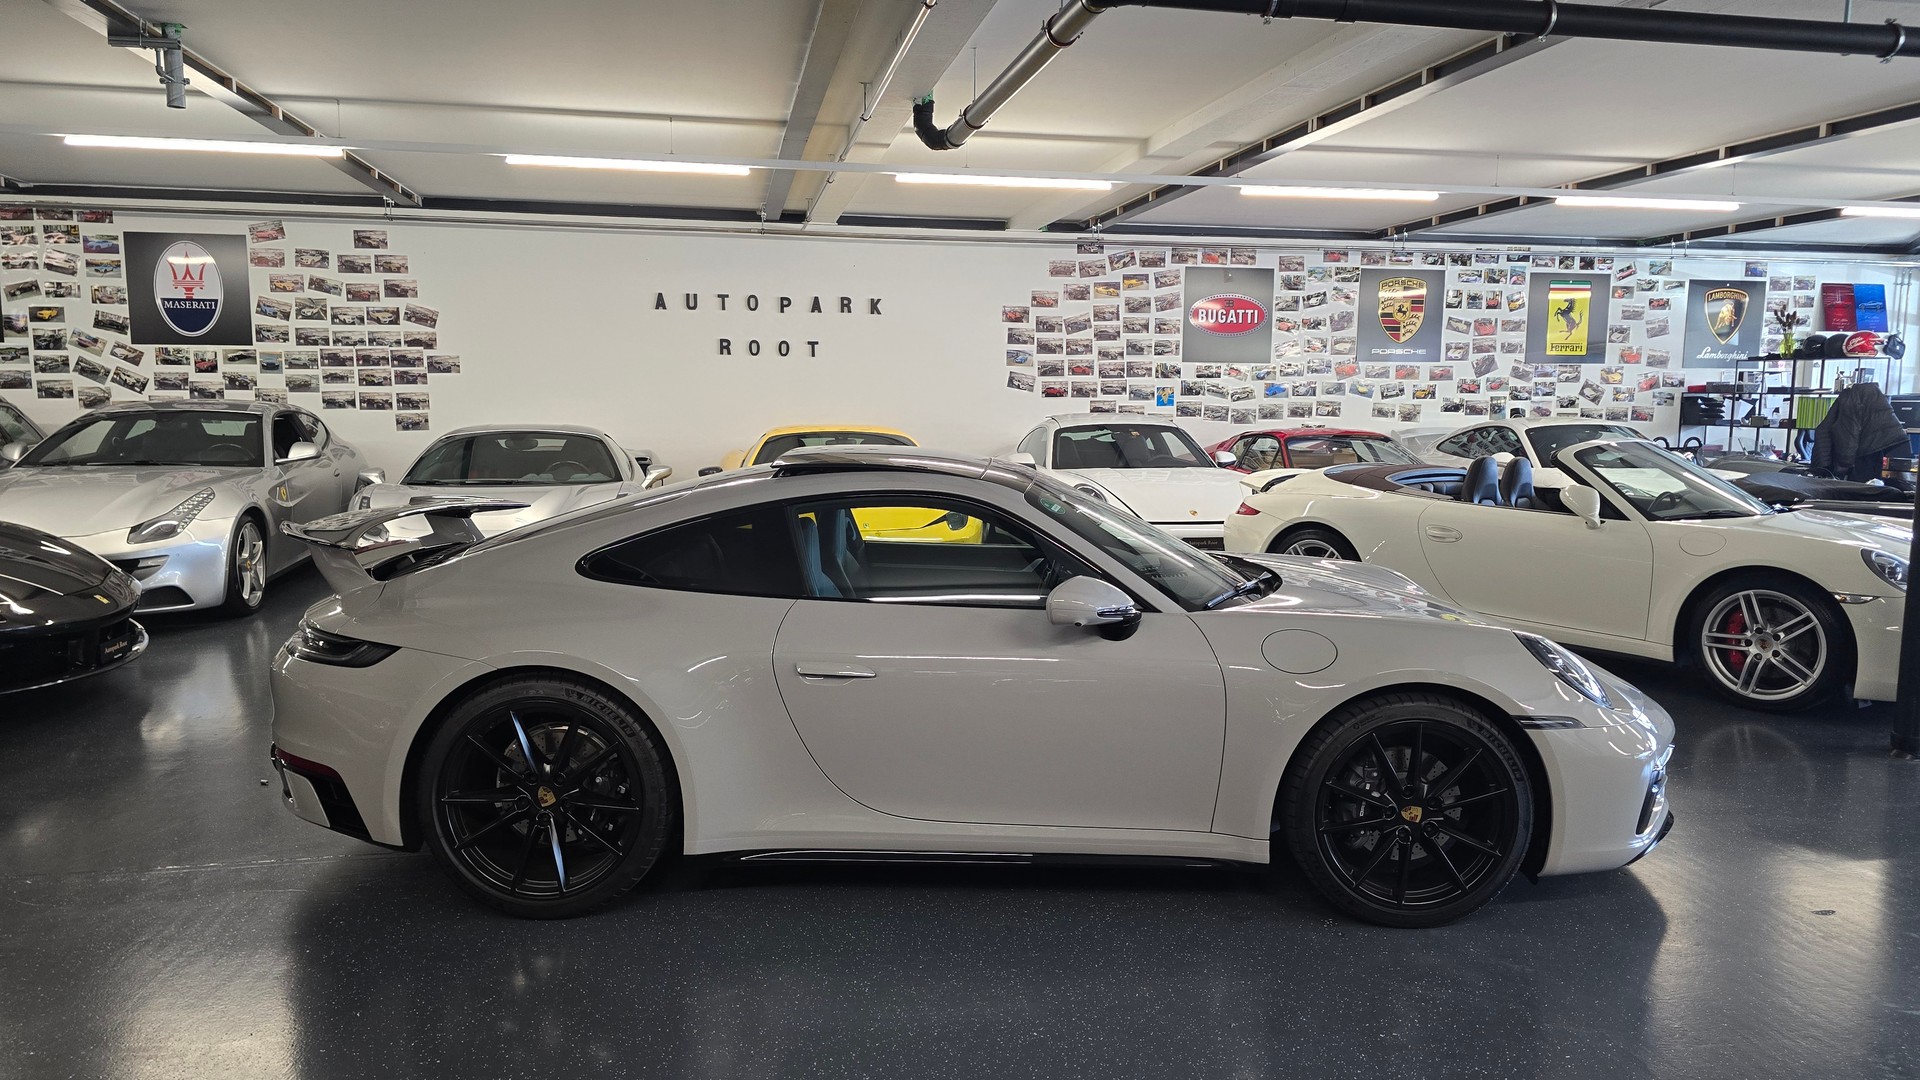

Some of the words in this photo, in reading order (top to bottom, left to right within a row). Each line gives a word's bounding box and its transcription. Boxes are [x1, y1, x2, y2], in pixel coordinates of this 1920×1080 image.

[1381, 280, 1424, 289] PORSCHE
[164, 300, 216, 309] MASERATI
[654, 292, 882, 315] AUTOPARK
[1198, 308, 1259, 324] BUGATTI
[718, 338, 819, 357] ROOT
[1550, 342, 1583, 352] Ferrari
[1696, 346, 1749, 362] Lamborghini
[580, 694, 634, 736] MICHELIN
[1481, 729, 1522, 779] MICHELIN
